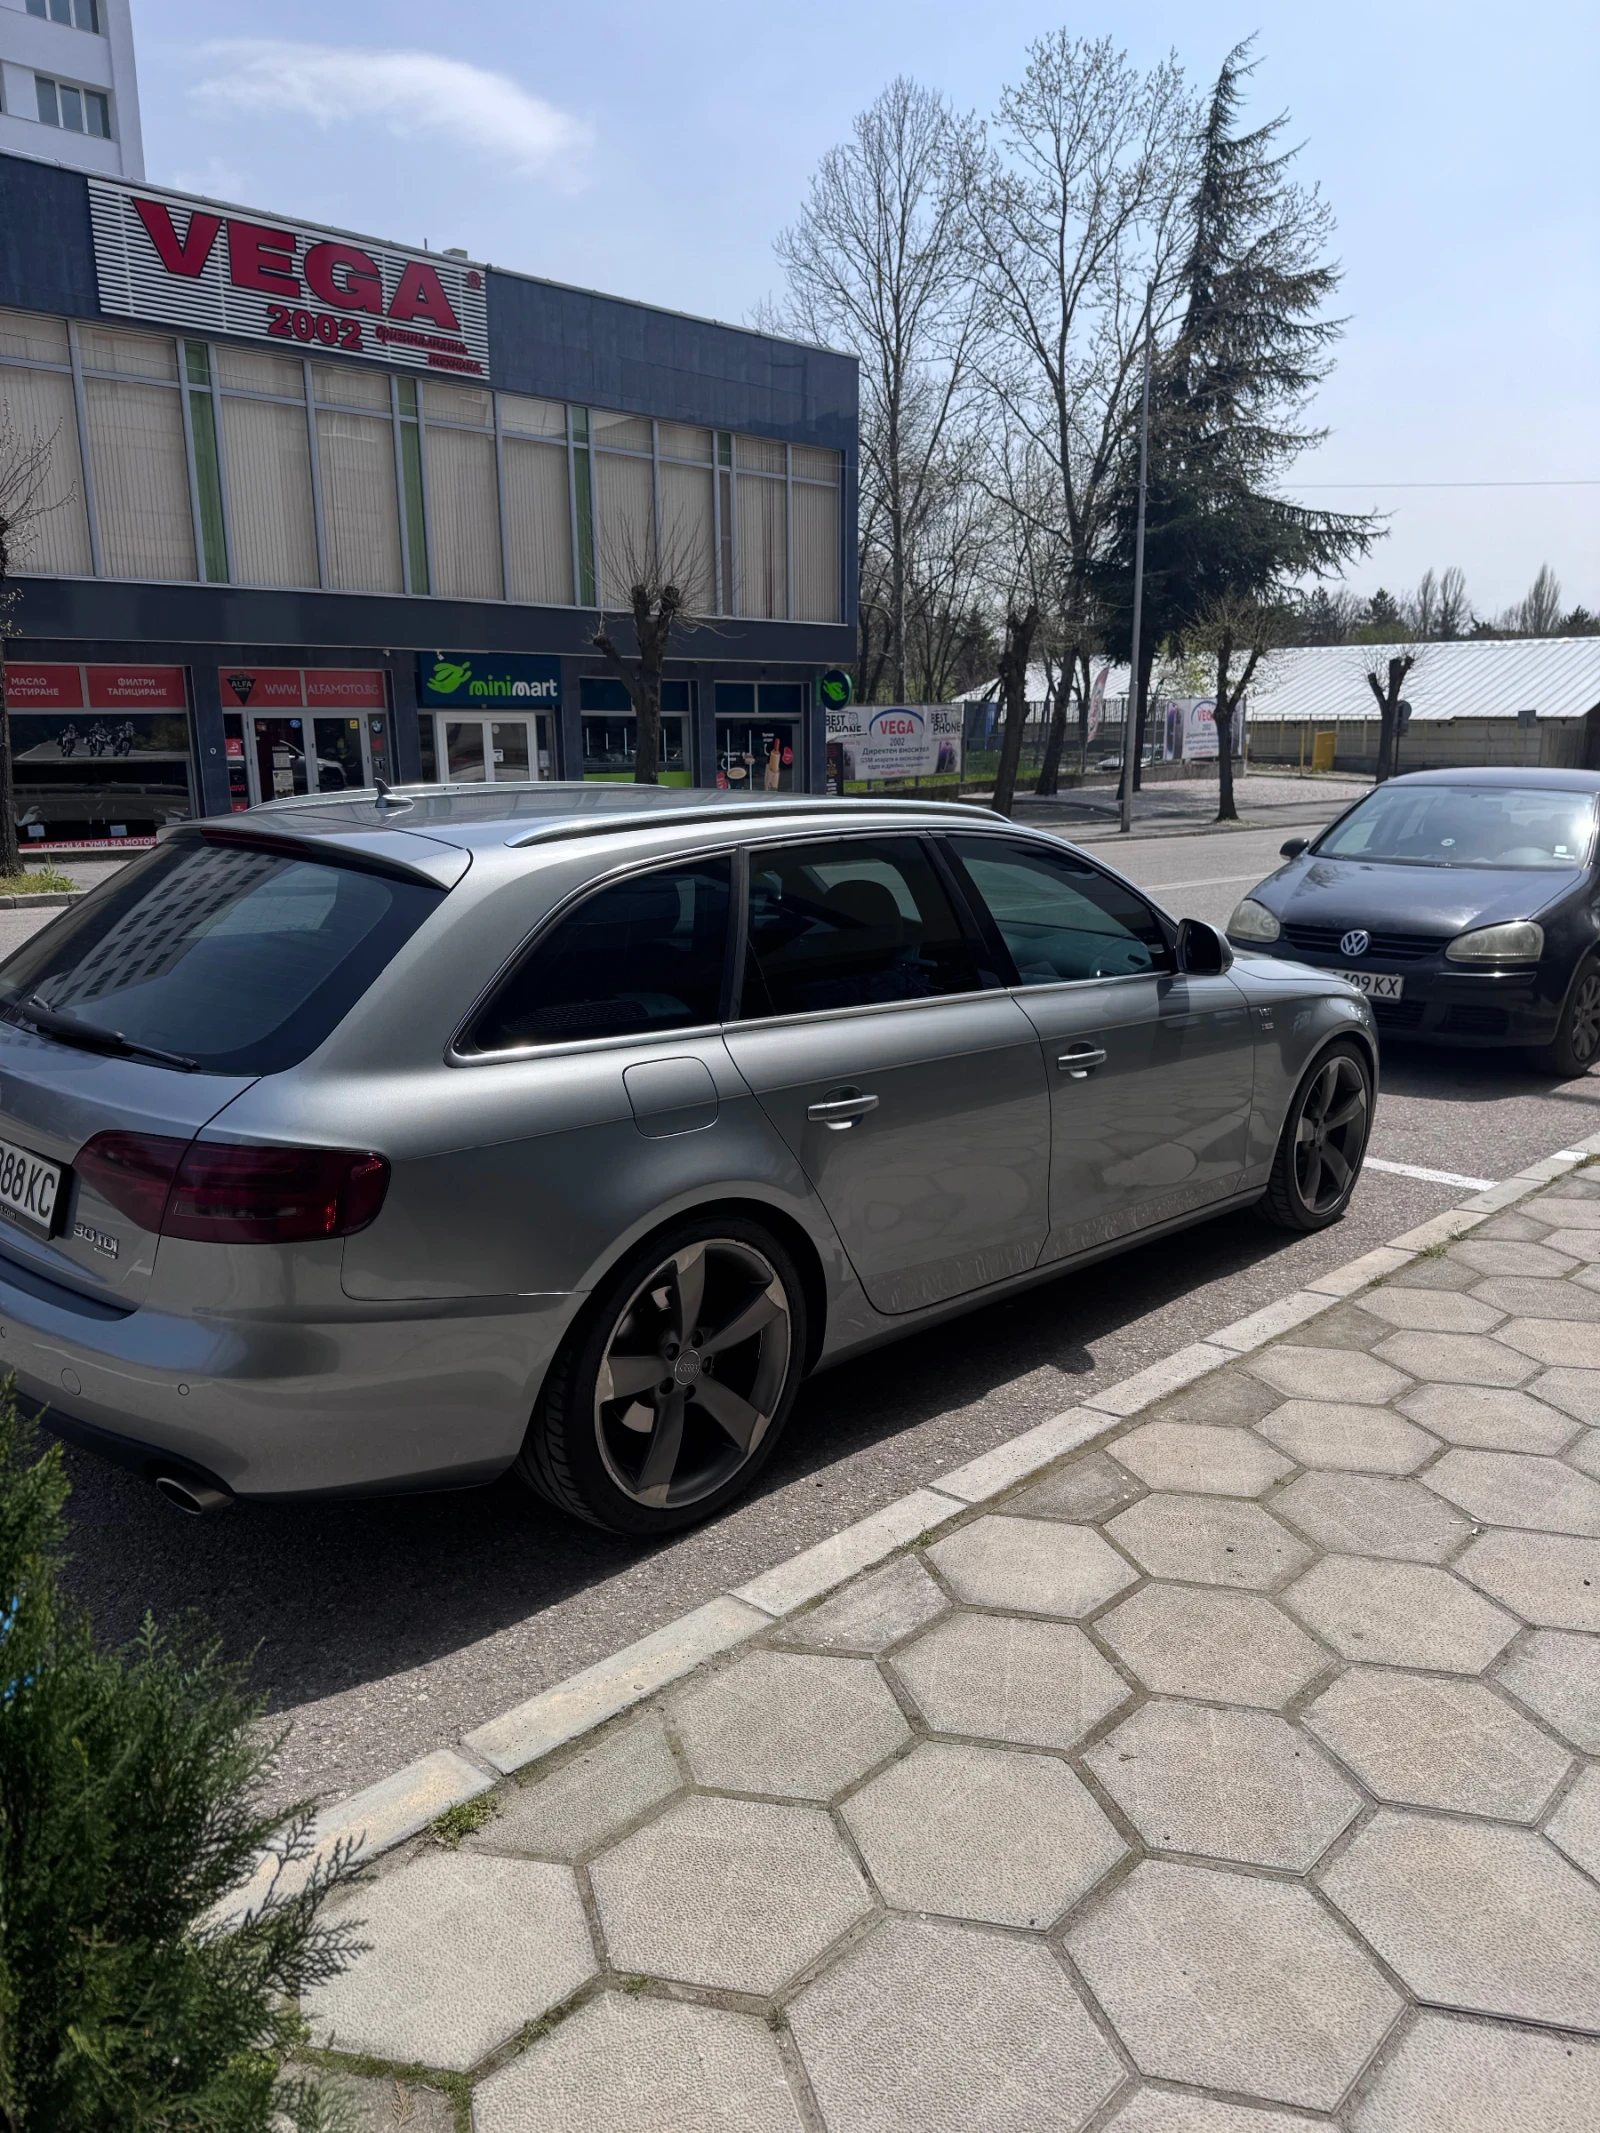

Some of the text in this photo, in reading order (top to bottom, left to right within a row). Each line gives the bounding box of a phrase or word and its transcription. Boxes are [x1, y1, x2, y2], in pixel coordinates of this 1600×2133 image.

[129, 196, 461, 331] VEGA
[266, 304, 363, 350] 2002
[427, 353, 483, 375] техника
[11, 677, 47, 686] МАСЛО
[118, 678, 155, 686] ФИЛТРИ
[469, 675, 558, 697] minimart
[107, 688, 167, 696] ТАПИЦИРАНЕ
[307, 684, 379, 695] ALFAMOTO.BG
[931, 713, 948, 724] BEST
[880, 719, 915, 735] VEGA
[933, 722, 961, 735] PHONE
[890, 737, 905, 747] 2002
[862, 747, 898, 756] Директен
[84, 840, 108, 848] ГУМИ
[110, 839, 122, 847] ЗА
[0, 1146, 55, 1218] 88KC
[97, 1231, 118, 1253] TDI
